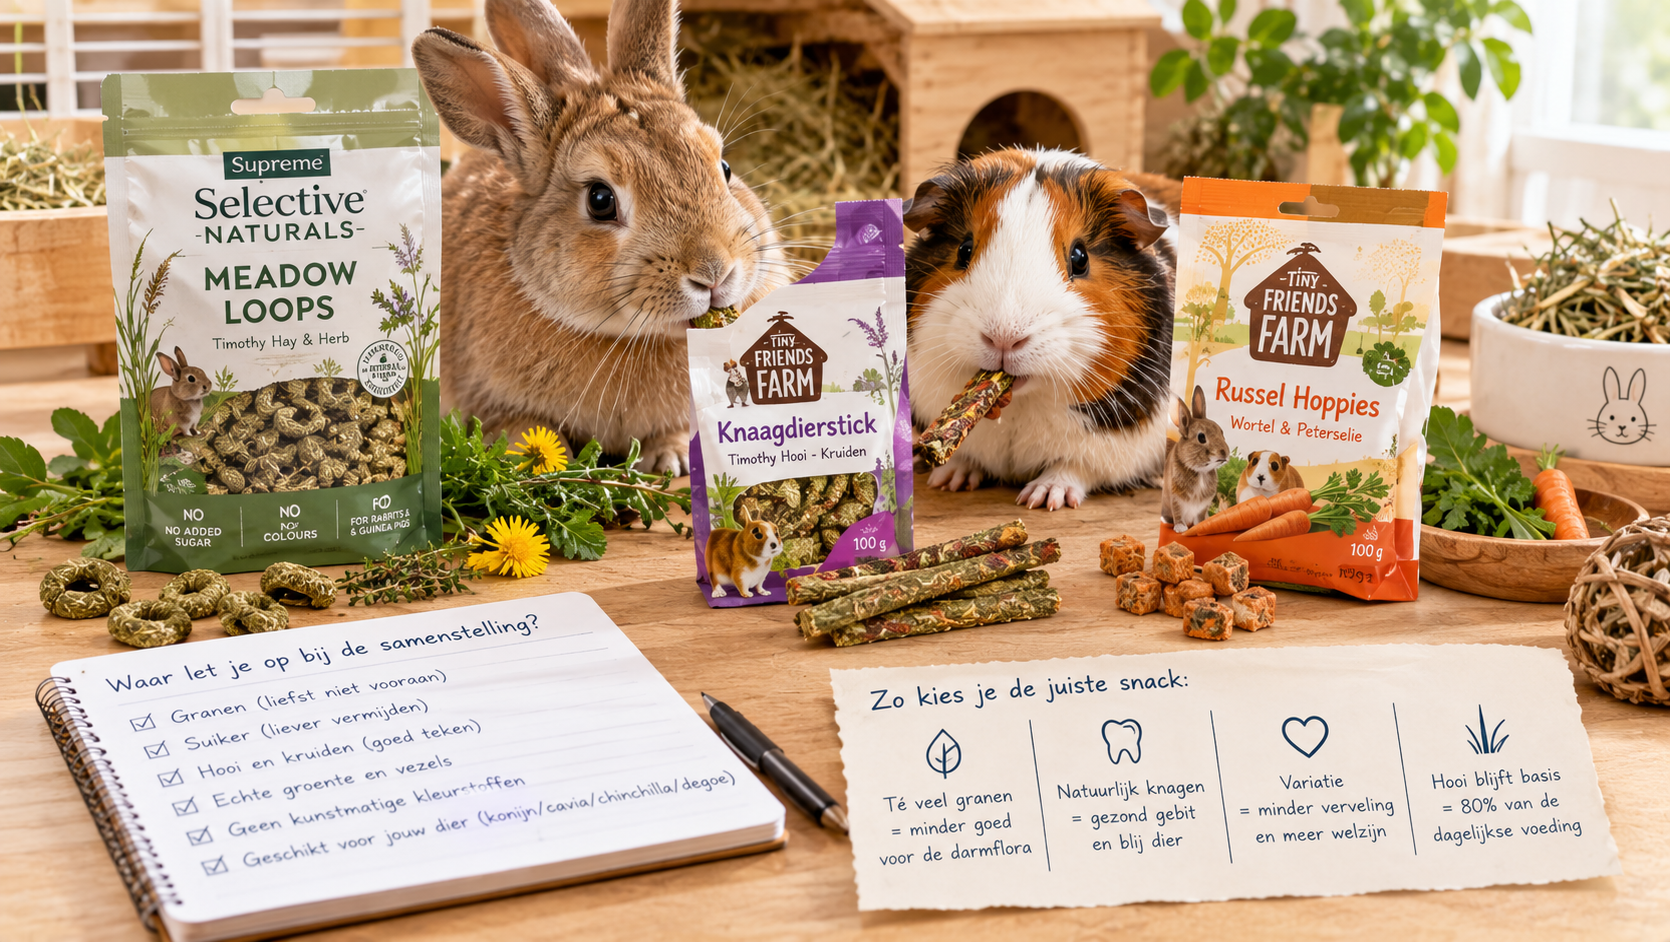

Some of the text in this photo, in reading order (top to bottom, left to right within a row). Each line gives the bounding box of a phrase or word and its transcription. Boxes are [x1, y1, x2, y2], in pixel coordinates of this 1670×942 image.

[204, 260, 357, 291] MEADOW
[225, 295, 335, 324] LOOPS
[1263, 289, 1338, 316] FRIENDS
[212, 332, 350, 350] Timothy Hay & Herb
[1257, 315, 1334, 359] FARM
[754, 347, 814, 367] FRIENDS
[757, 368, 815, 399] FARM
[1215, 377, 1380, 422] Russel Hoppies
[717, 412, 878, 447] Knaagdierstick
[1230, 415, 1362, 443] Wortel & Peterselie
[728, 452, 777, 467] Timothy
[781, 449, 807, 463] Hooi
[821, 446, 867, 459] Kruiden
[182, 508, 204, 522] NO
[279, 504, 301, 518] NO
[350, 516, 369, 526] FOR
[165, 526, 222, 537] NO ADDED
[263, 529, 318, 542] COLOURS
[358, 523, 393, 535] GUINEA
[175, 536, 212, 547] SUGAR
[853, 536, 887, 552] 100 g
[1350, 543, 1383, 561] 100 g
[105, 613, 539, 693] Waar let je op bij de samenstelling?
[171, 668, 447, 725] Granen (liefst niet vooraan)
[870, 668, 1190, 711] Zo kies je de juiste snack:
[184, 698, 429, 751] Suiker (liever vermijden)
[198, 718, 482, 779] Hooi en kruiden (goed teken)
[212, 754, 453, 808] Echte groente en vezels
[1057, 779, 1206, 802] Natuurlijk knagen
[1279, 773, 1345, 790] Variatie
[1431, 768, 1562, 791] Hooi blijft basis
[228, 775, 526, 838] Geen kunstmatige kleurstoffen
[883, 790, 1014, 812] Té veel granen
[1239, 797, 1395, 817] = minder verveling
[1442, 792, 1560, 814] = 80% van de
[891, 812, 1012, 836] = minder goed
[1072, 804, 1197, 830] = gezond gebit
[242, 840, 330, 868] Geschikt
[337, 835, 376, 851] voor
[386, 825, 427, 847] jouw
[435, 816, 469, 833] dier
[1092, 832, 1183, 854] en blij dier
[1256, 823, 1387, 844] en meer welzijn
[1433, 818, 1582, 846] dagelijkse voeding
[879, 840, 1032, 866] voor de darmflora
